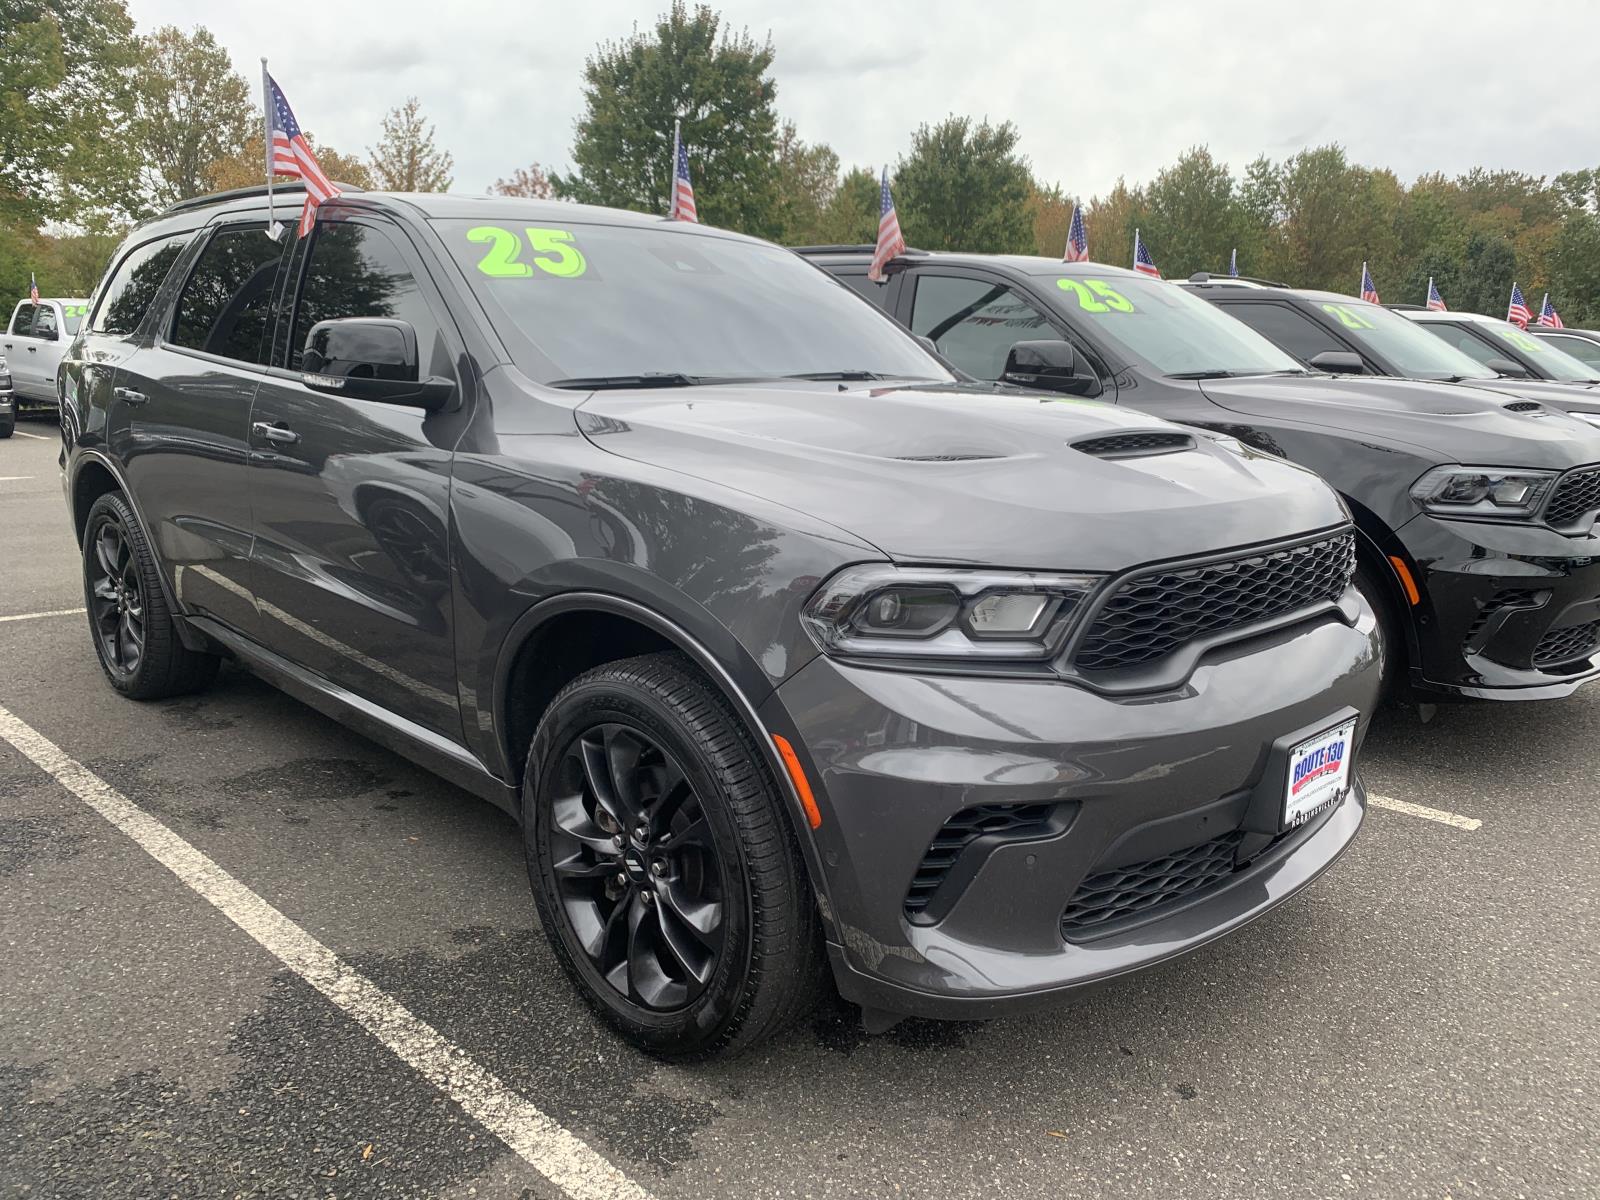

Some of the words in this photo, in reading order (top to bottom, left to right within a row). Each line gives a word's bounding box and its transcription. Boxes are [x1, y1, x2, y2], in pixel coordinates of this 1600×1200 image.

[466, 226, 587, 278] 25
[1056, 278, 1135, 313] 25
[1293, 747, 1325, 784] ROUTE
[1327, 741, 1344, 762] 130
